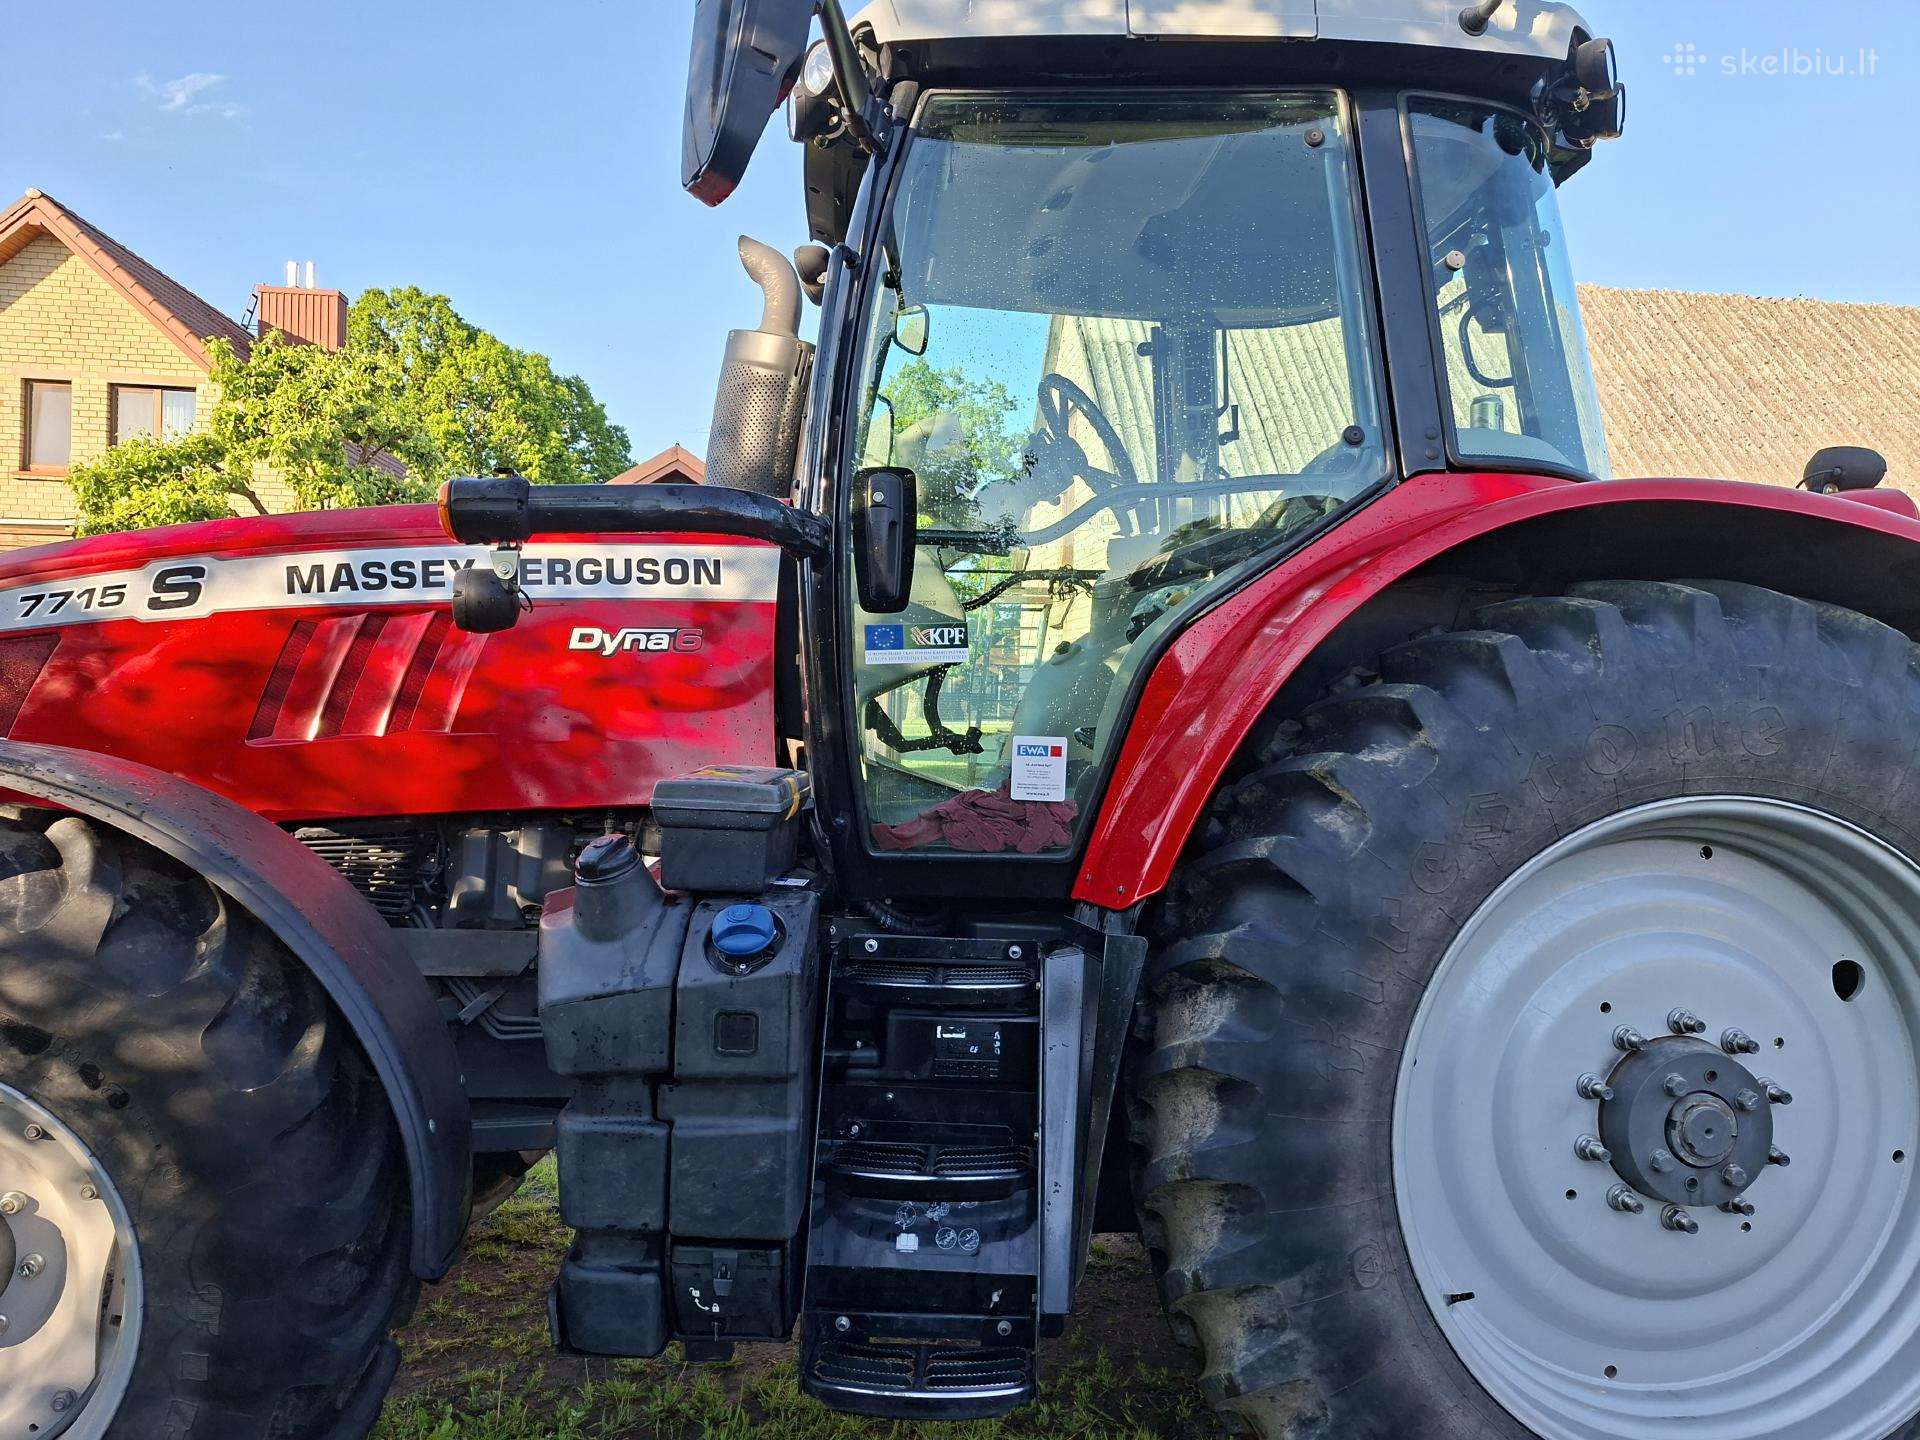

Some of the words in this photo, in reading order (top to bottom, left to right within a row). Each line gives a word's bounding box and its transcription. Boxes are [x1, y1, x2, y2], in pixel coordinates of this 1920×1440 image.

[519, 558, 722, 586] ERGUSON
[19, 583, 128, 618] 7715
[147, 565, 207, 611] S
[1019, 745, 1047, 756] EWA
